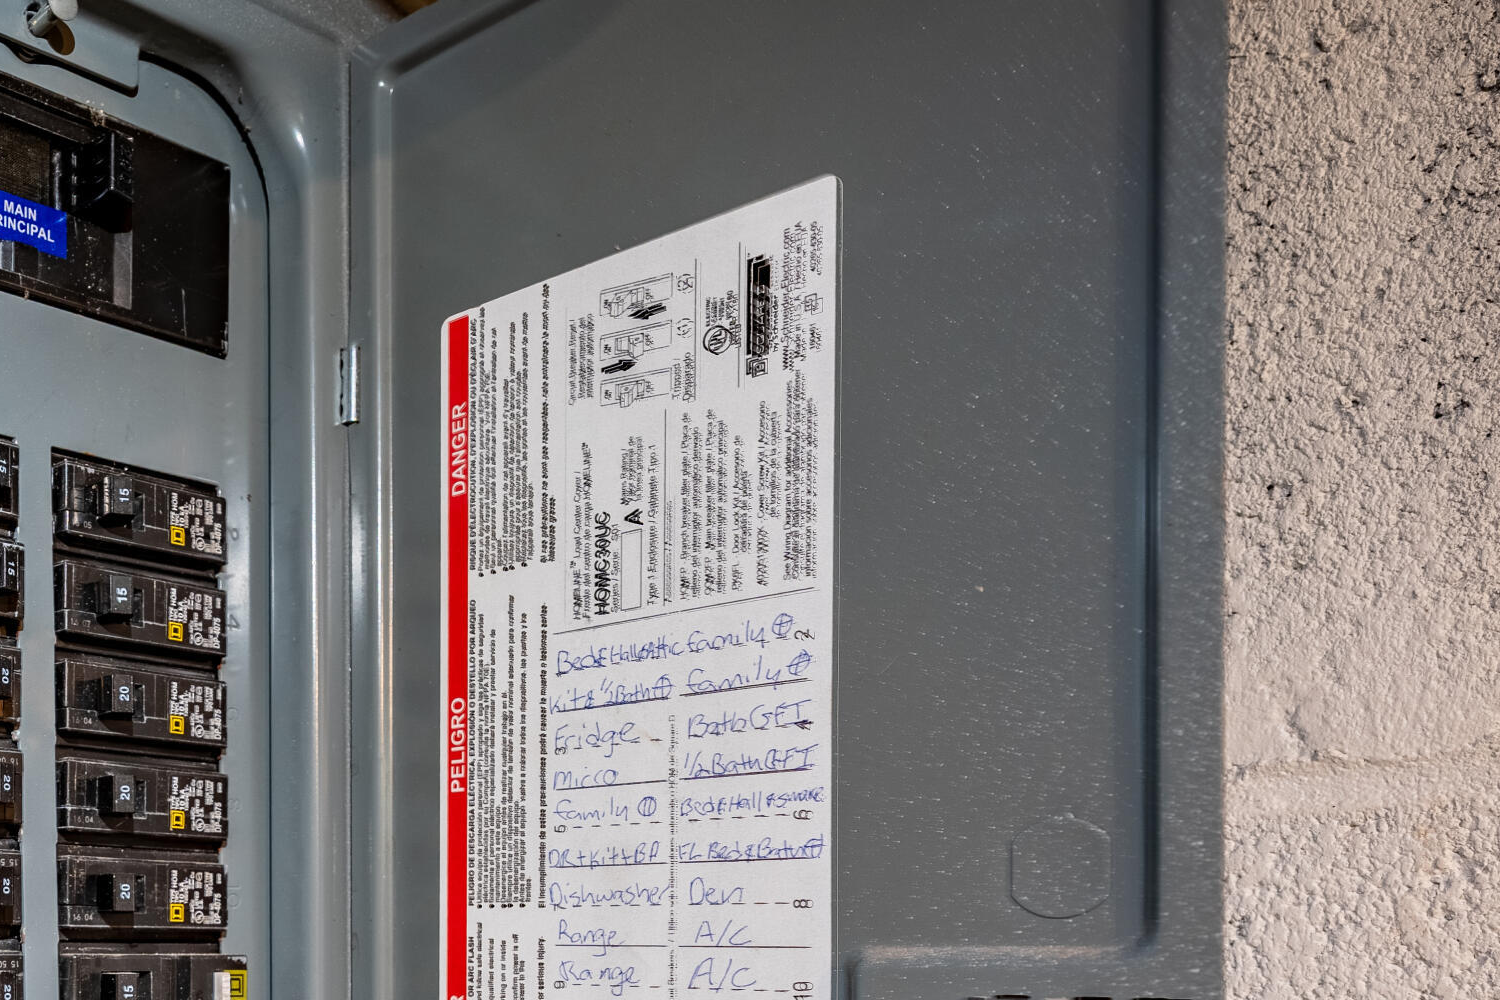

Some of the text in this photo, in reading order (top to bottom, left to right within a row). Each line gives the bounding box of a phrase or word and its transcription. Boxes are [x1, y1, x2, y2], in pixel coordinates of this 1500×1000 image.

[3, 199, 37, 221] MAIN
[451, 401, 468, 497] DANGER
[0, 459, 6, 473] 15
[120, 489, 129, 502] 15
[8, 561, 15, 576] 15
[594, 512, 611, 615] HOMC30UC
[116, 587, 127, 603] 15
[1, 668, 9, 684] 20
[119, 686, 129, 701] 20
[451, 697, 466, 794] PELIGRO
[3, 775, 11, 791] 20
[120, 785, 130, 800] 20
[2, 878, 10, 894] 20
[121, 883, 130, 899] 20
[4, 985, 12, 1000] 20
[124, 985, 134, 999] 15
[467, 986, 474, 997] OR
